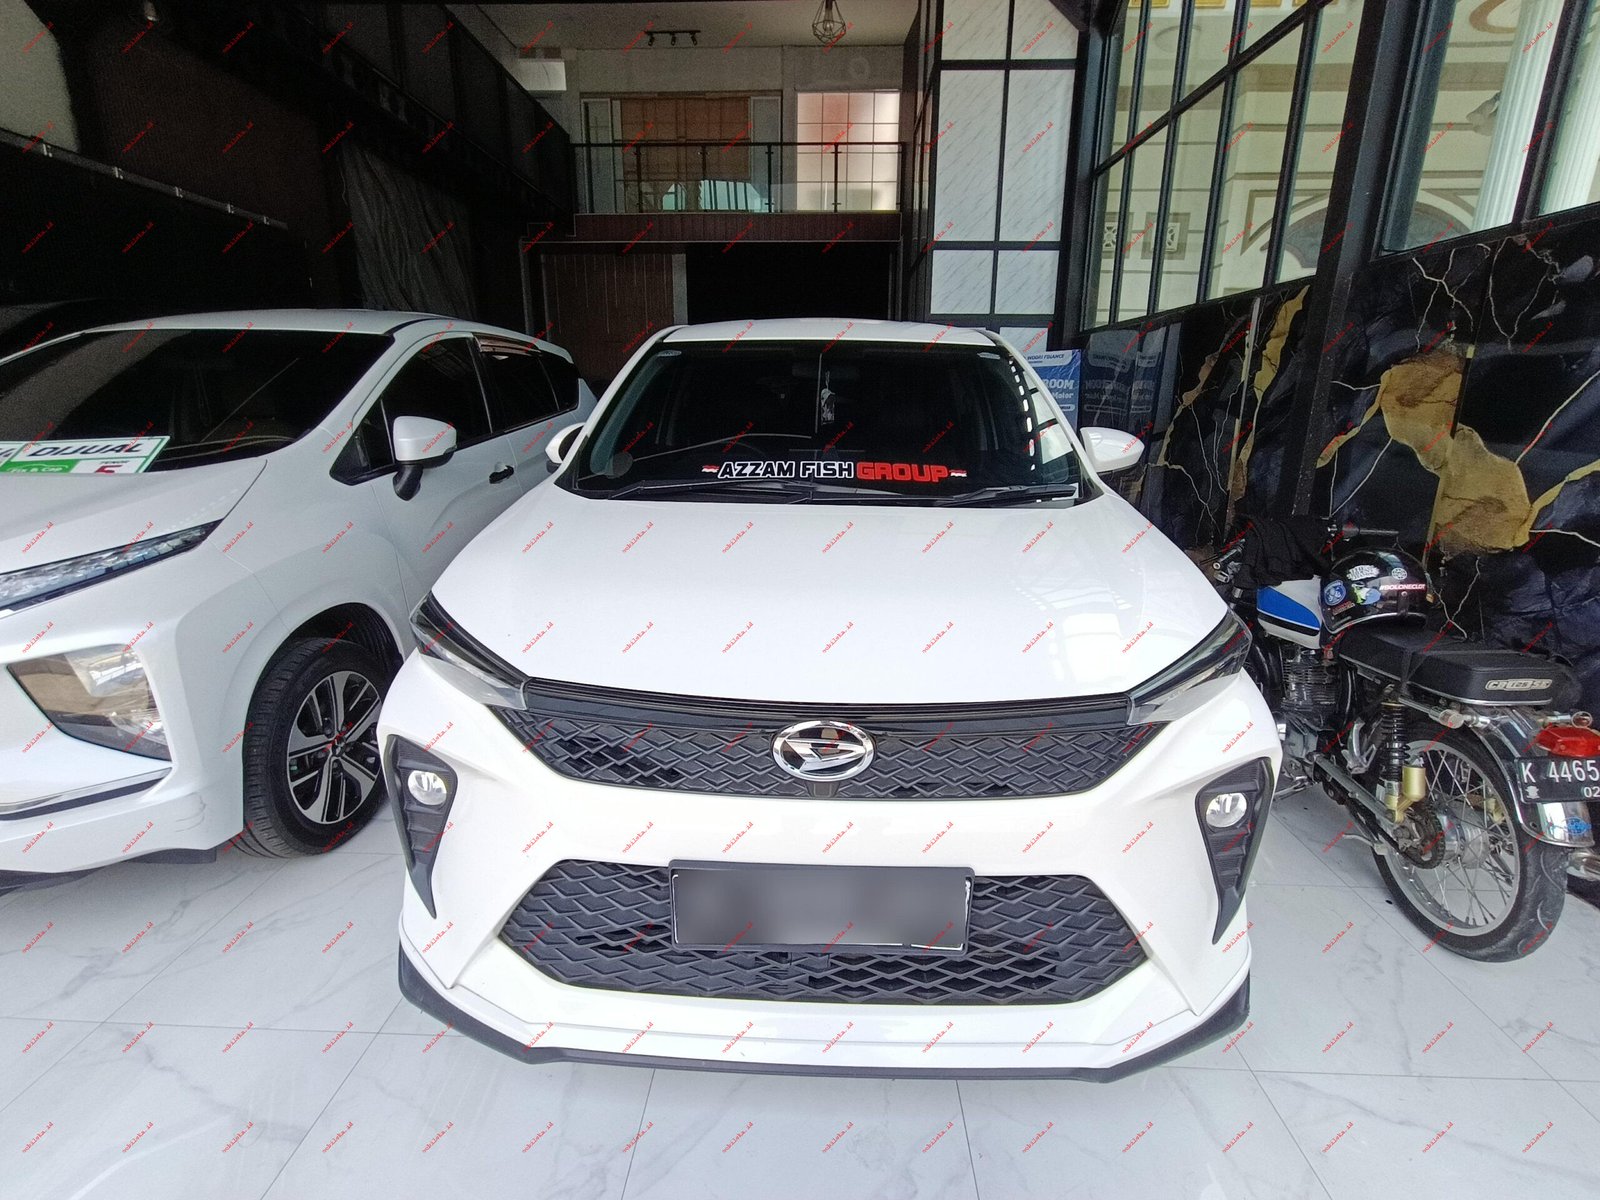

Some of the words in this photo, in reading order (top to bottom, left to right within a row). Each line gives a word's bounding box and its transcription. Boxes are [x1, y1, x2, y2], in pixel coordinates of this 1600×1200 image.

[28, 444, 143, 456] DIJUAL
[718, 461, 796, 479] AZZAM
[799, 461, 854, 479] FISH
[856, 461, 949, 483] GROUP
[1521, 762, 1537, 784] K
[1549, 759, 1600, 783] 4465
